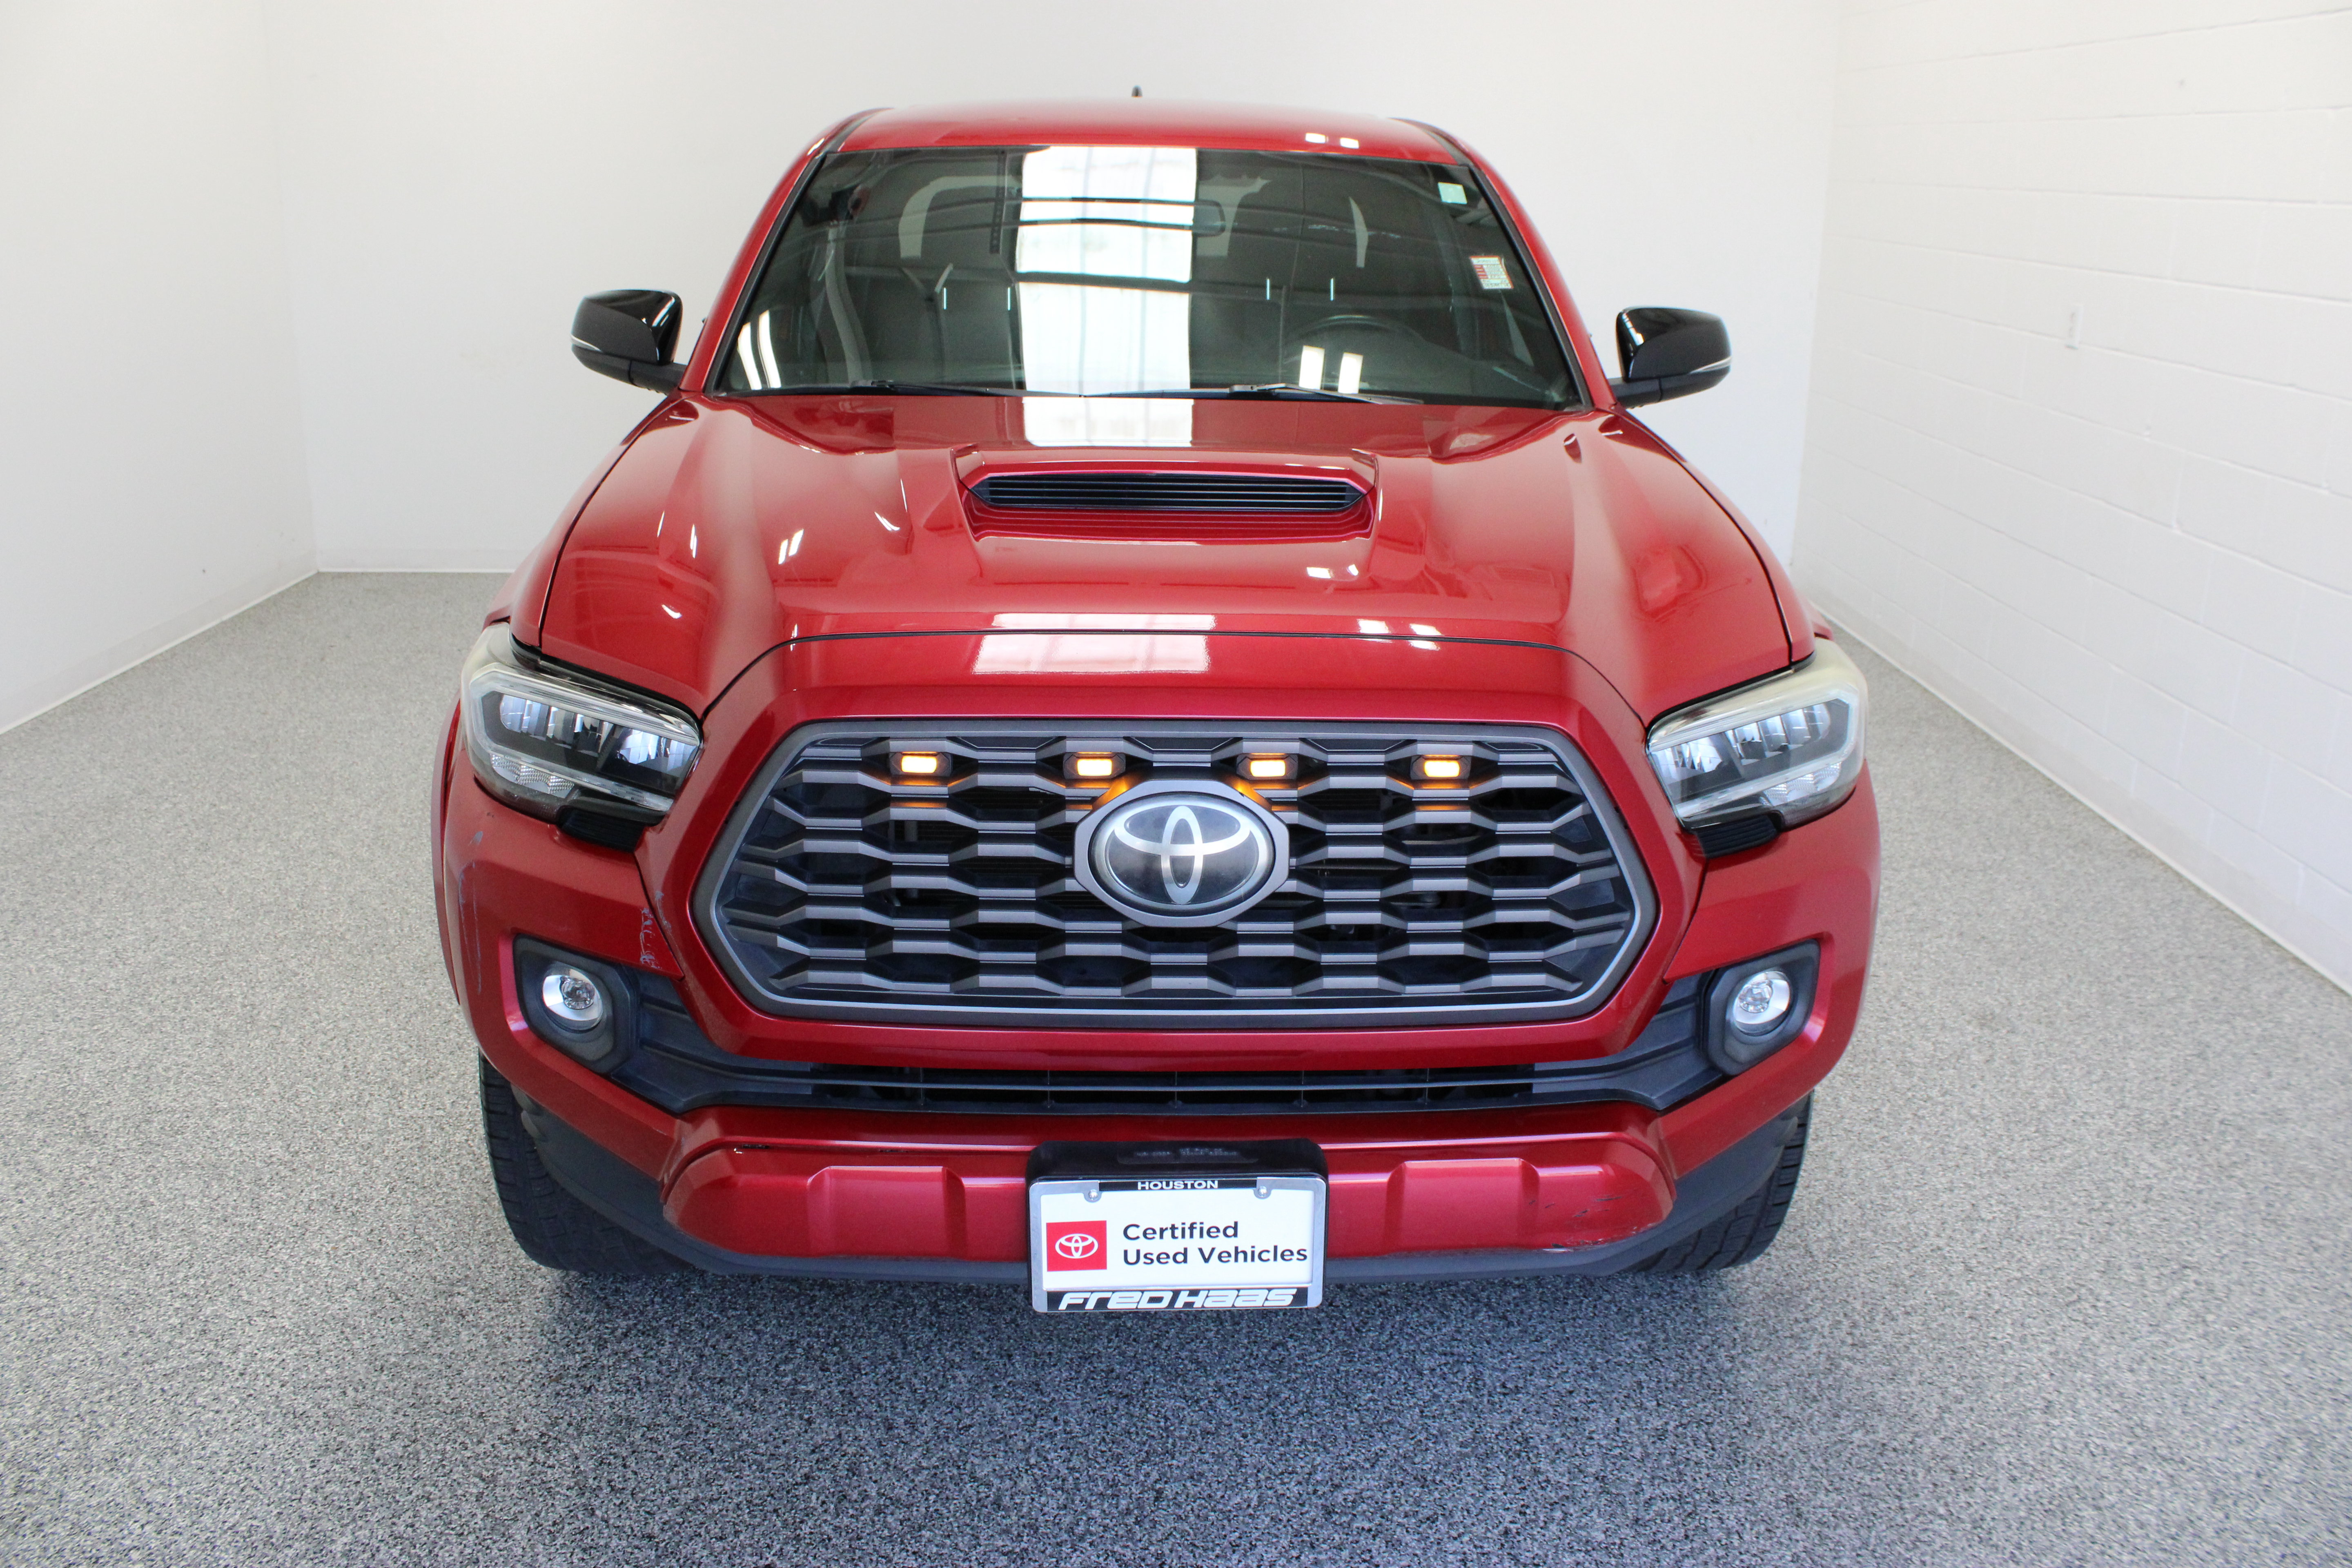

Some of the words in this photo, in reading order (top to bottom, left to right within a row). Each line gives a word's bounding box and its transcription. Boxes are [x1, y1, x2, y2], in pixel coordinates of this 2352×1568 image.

[1138, 1180, 1218, 1190] HOUSTON
[1123, 1221, 1238, 1241] Certified
[1123, 1247, 1188, 1265] Used
[1198, 1245, 1307, 1263] Vehicles
